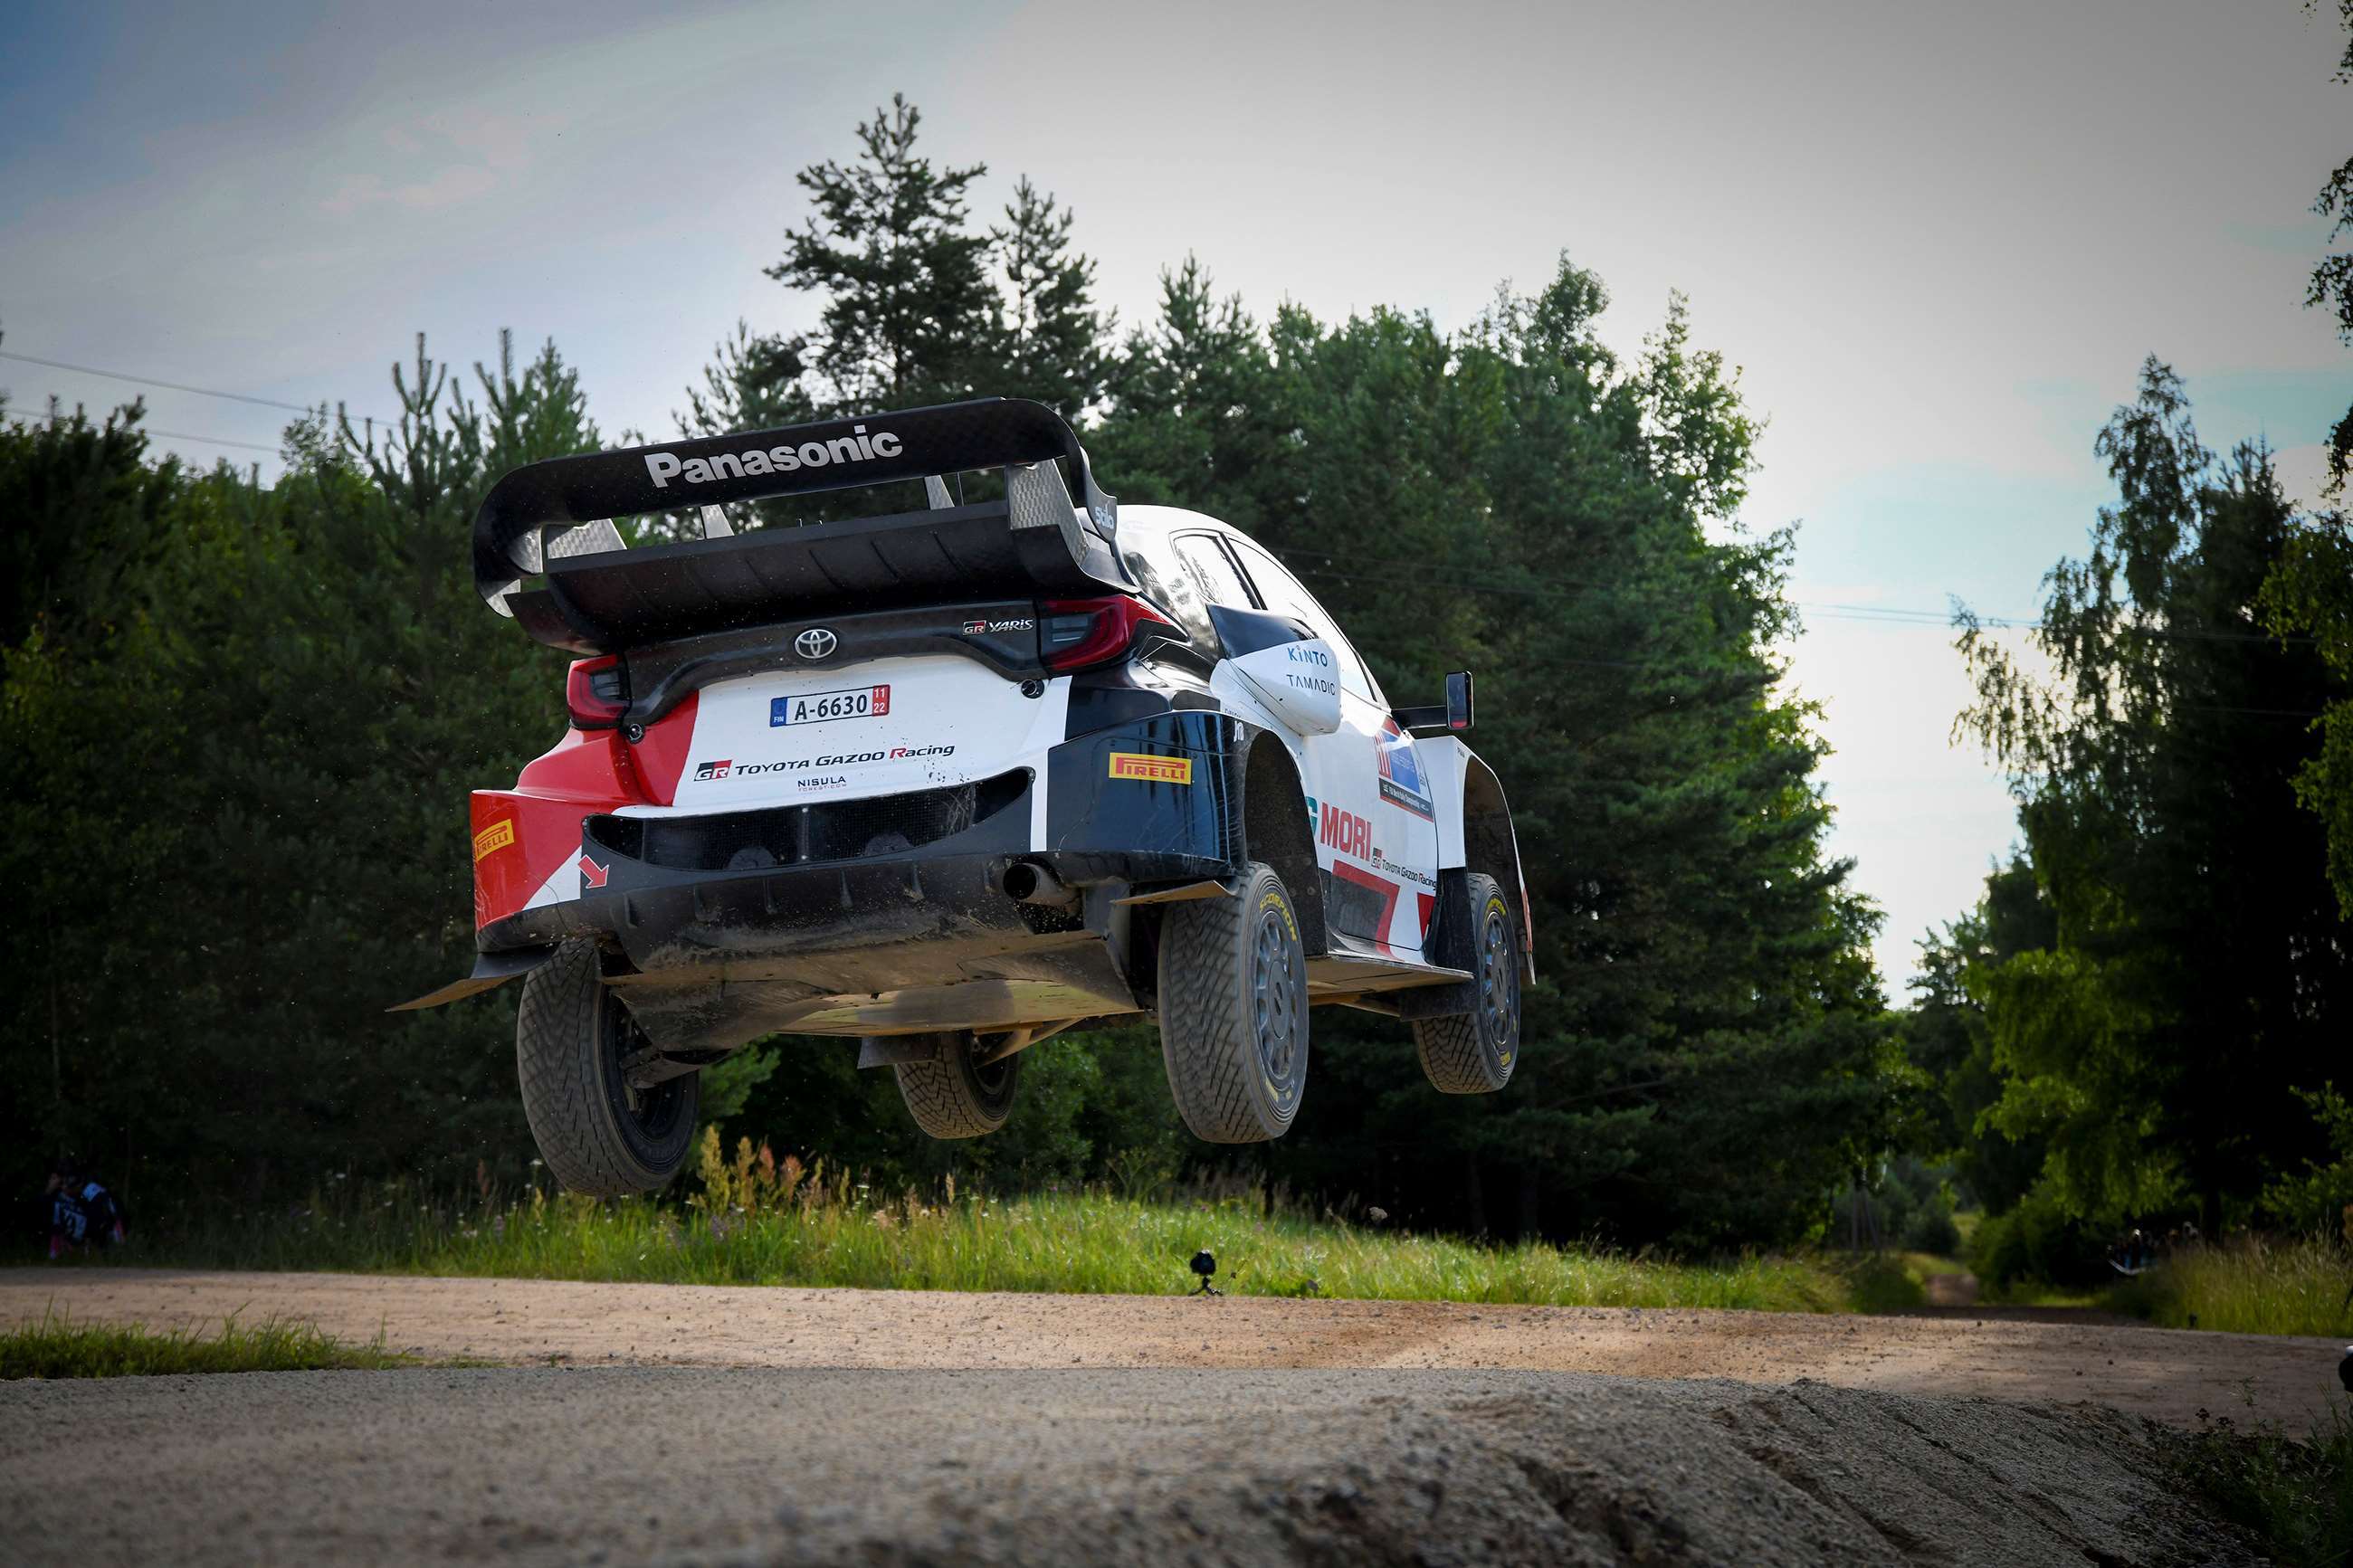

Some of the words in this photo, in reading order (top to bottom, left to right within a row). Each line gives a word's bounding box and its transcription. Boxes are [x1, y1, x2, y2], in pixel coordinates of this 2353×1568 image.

[644, 424, 903, 489] Panasonic
[964, 623, 986, 634] GR
[989, 619, 1034, 632] YARIS
[874, 688, 886, 698] 11
[1286, 674, 1336, 696] TAMADIC
[795, 694, 868, 721] A-6630
[873, 702, 886, 713] 22
[695, 765, 731, 781] GR
[735, 759, 810, 775] TOYOTA
[815, 751, 885, 766] GAZOO
[890, 745, 956, 760] Racing
[1115, 756, 1186, 780] PIRELLI
[797, 775, 846, 787] NISULA
[1320, 802, 1372, 862] MORI
[1382, 859, 1402, 877] TOYOTA
[1418, 872, 1437, 891] Racing
